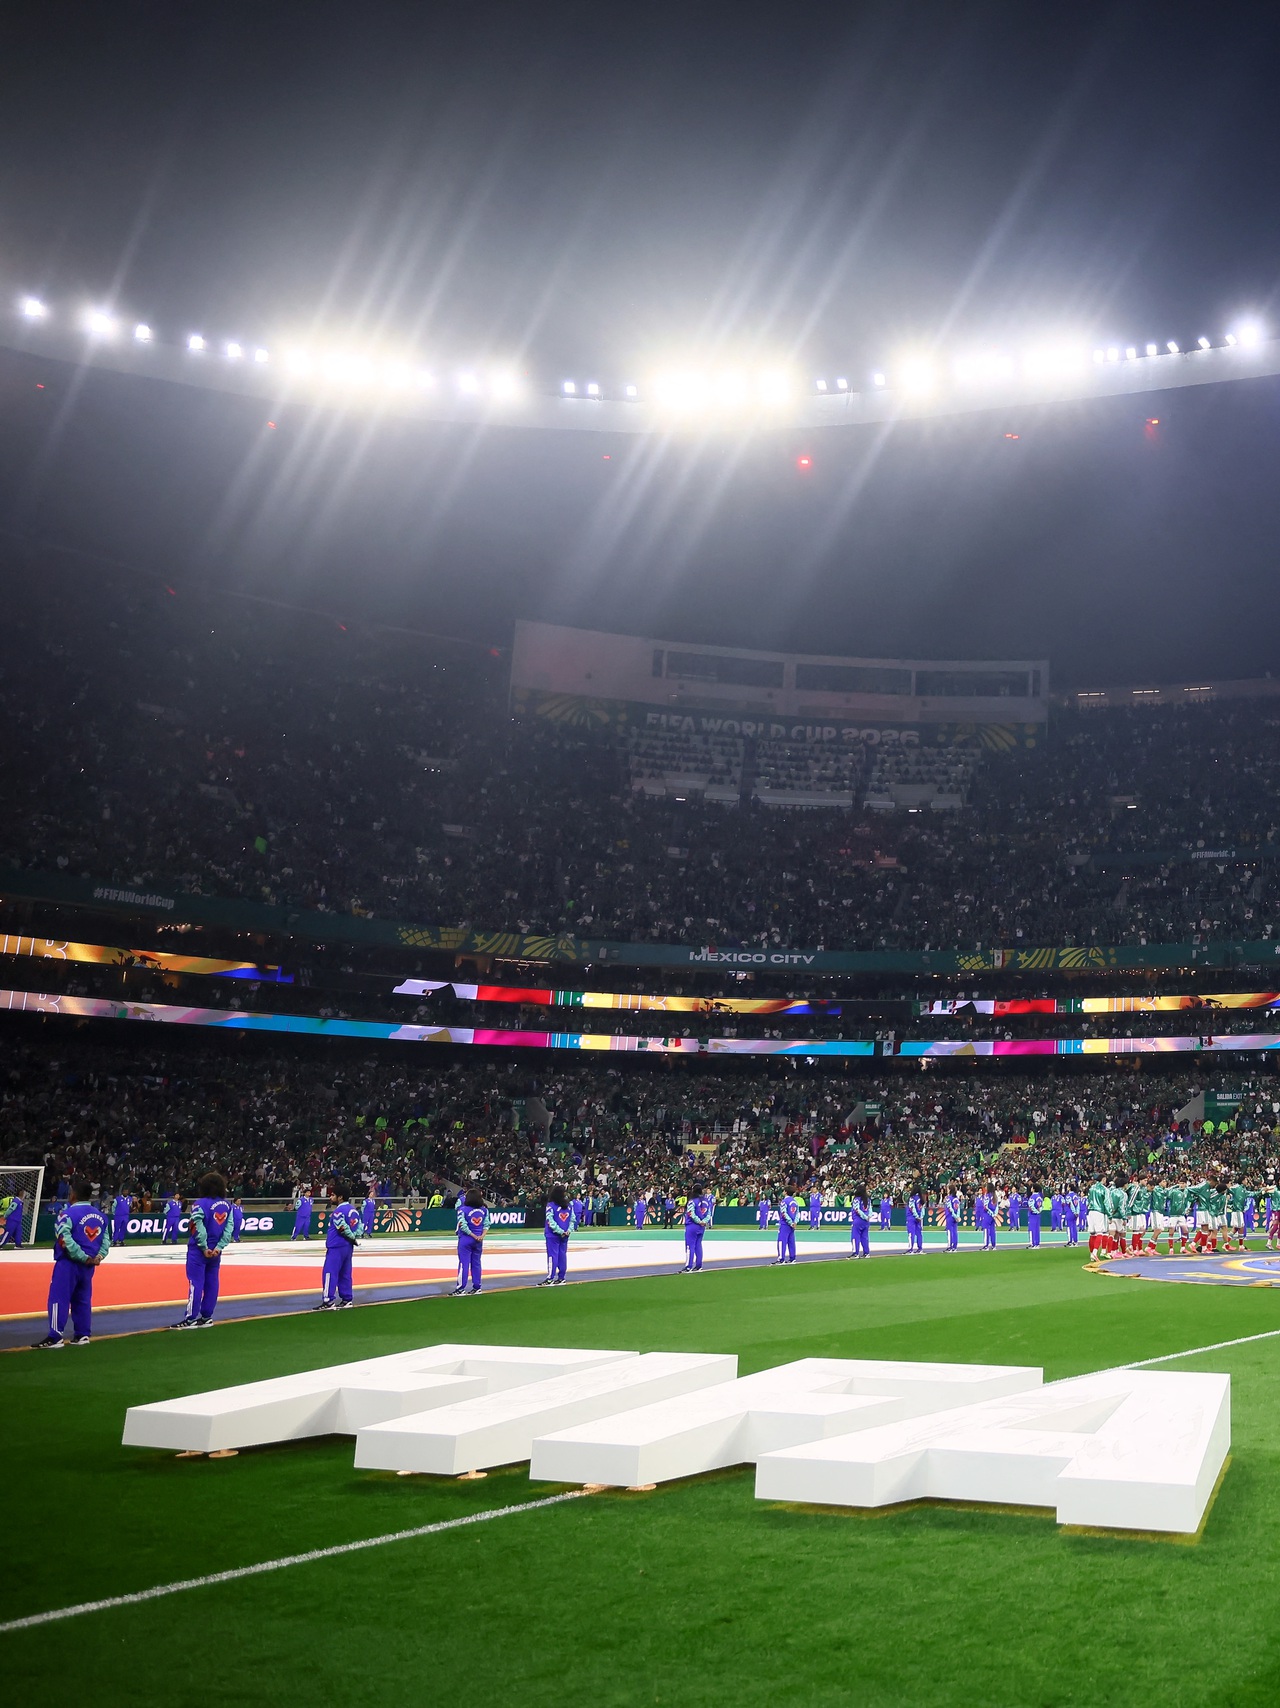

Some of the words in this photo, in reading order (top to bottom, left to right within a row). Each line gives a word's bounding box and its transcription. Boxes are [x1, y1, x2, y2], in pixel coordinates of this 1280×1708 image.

[646, 712, 695, 732] FIFA
[700, 717, 786, 739] WORLD
[791, 725, 837, 743] CUP
[1191, 850, 1235, 859] #FIFAWorldCp
[93, 887, 175, 910] #FIFAWorldCup
[689, 952, 767, 963] MEXICO
[770, 954, 816, 965] CITY
[489, 1212, 526, 1225] WORL
[756, 1210, 780, 1221] FFA
[824, 1210, 847, 1222] CUP
[124, 1343, 1233, 1534] FIFA
